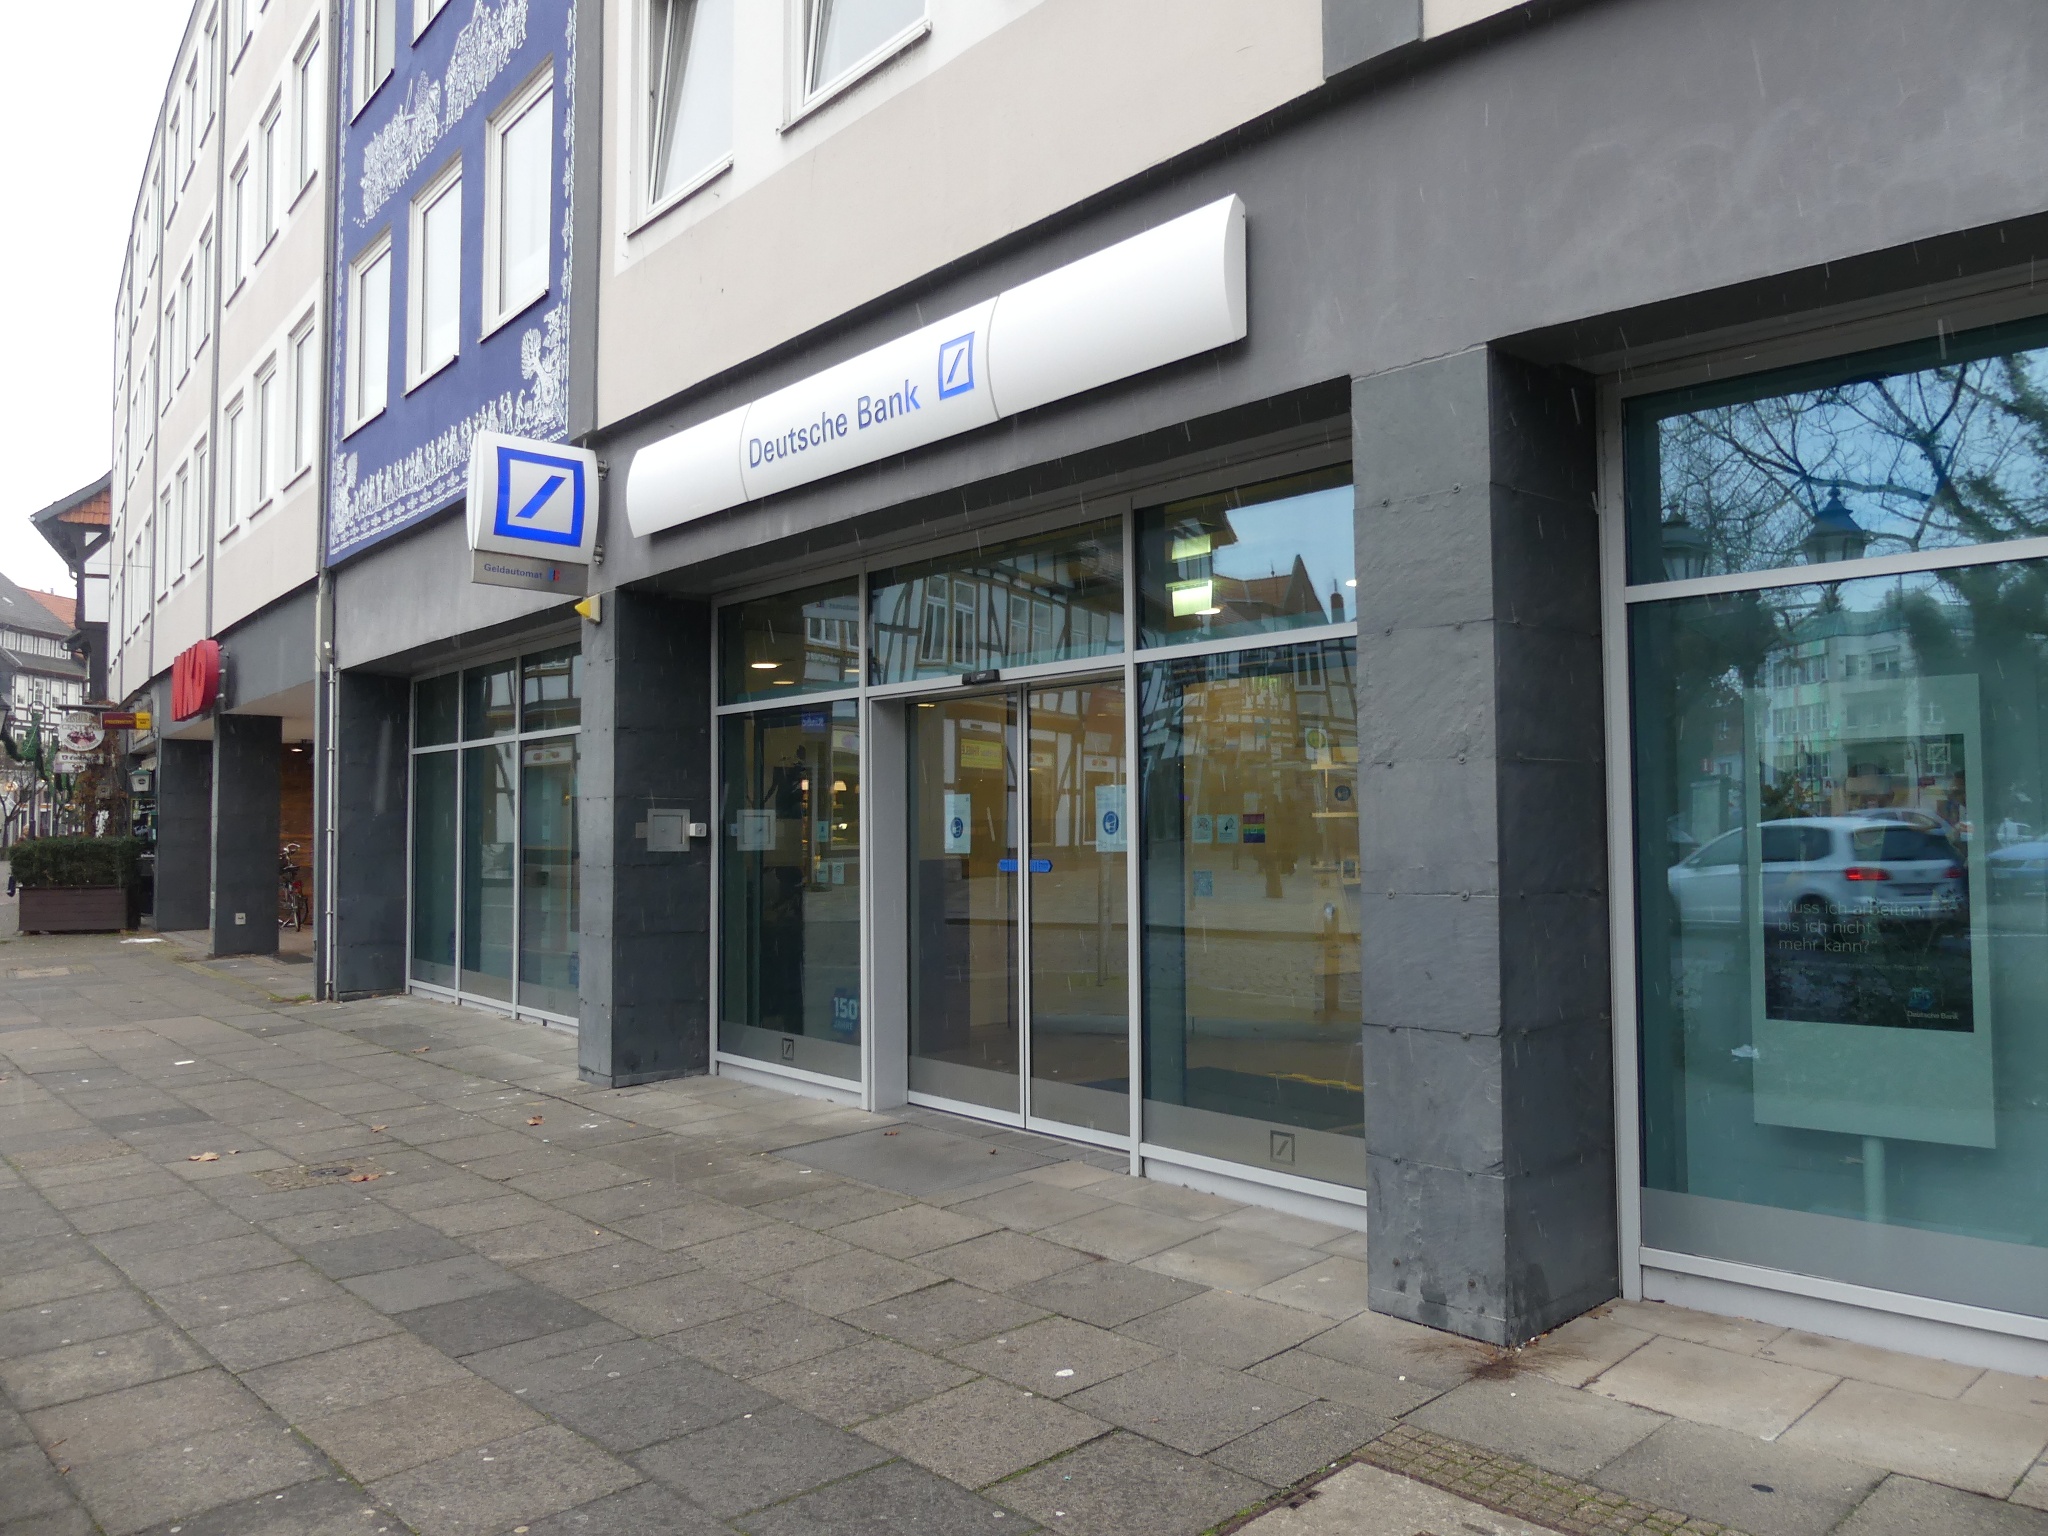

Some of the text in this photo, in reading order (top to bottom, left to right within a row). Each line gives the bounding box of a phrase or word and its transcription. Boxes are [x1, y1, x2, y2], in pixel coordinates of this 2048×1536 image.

[750, 379, 921, 469] Deutsche Bank
[484, 562, 543, 580] Geldautomat
[1824, 900, 1847, 915] ich
[1778, 917, 1871, 934] bis ich nicht
[1778, 937, 1818, 952] mehr
[833, 997, 858, 1019] 150
[1906, 1010, 1959, 1021] Deutsche Bank
